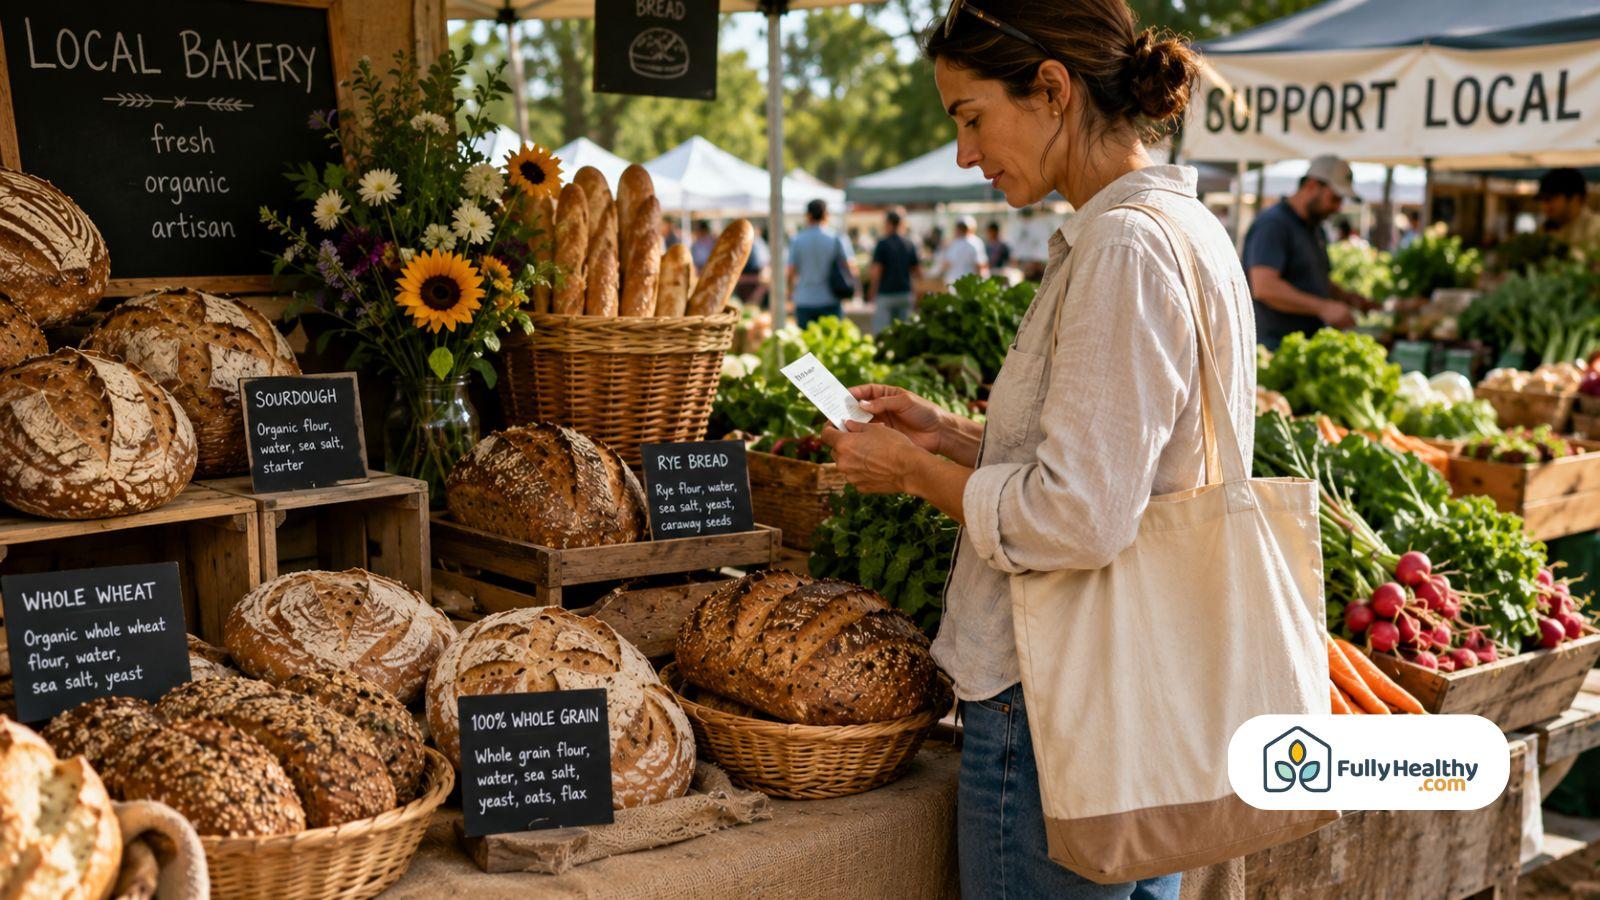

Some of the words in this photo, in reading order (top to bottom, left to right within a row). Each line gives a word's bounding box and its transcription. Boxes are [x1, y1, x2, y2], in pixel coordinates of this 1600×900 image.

[636, 0, 686, 21] BREAD
[25, 17, 162, 75] LOCAL
[179, 29, 316, 94] BAKERY
[1204, 80, 1397, 134] SUPPORT
[1424, 69, 1582, 129] LOCAL
[151, 122, 216, 154] fresh
[145, 171, 230, 205] organic
[151, 212, 236, 239] artisan
[255, 388, 337, 408] SOURDOUGH
[257, 422, 298, 440] Organic
[303, 418, 332, 432] flour,
[260, 442, 295, 455] water,
[298, 441, 316, 451] sea
[320, 436, 344, 450] salt,
[263, 459, 304, 474] starter
[657, 455, 682, 470] RYE
[688, 453, 728, 469] BREAD
[655, 483, 674, 501] Rye
[678, 481, 705, 495] flour,
[708, 481, 737, 492] water,
[659, 504, 676, 514] sea
[680, 499, 702, 512] salt,
[706, 497, 735, 515] yeast,
[661, 520, 701, 533] caraway
[706, 514, 732, 527] seeds
[21, 588, 86, 612] WHOLE
[95, 581, 156, 604] WHEAT
[24, 628, 78, 651] Organic
[85, 621, 122, 640] whole
[128, 616, 166, 634] wheat
[28, 653, 69, 671] flour,
[76, 647, 121, 664] water,
[32, 680, 58, 694] sea
[65, 670, 98, 690] salt,
[105, 664, 144, 691] yeast
[471, 711, 507, 731] 100%
[511, 710, 555, 728] WHOLE
[560, 707, 599, 725] GRAIN
[474, 746, 512, 764] Whole
[518, 746, 550, 767] grain
[557, 741, 590, 758] flour,
[477, 770, 518, 786] water,
[524, 770, 545, 782] sea
[552, 763, 580, 780] salt,
[478, 790, 519, 815] yeast,
[524, 788, 556, 805] oats,
[560, 784, 587, 802] flax
